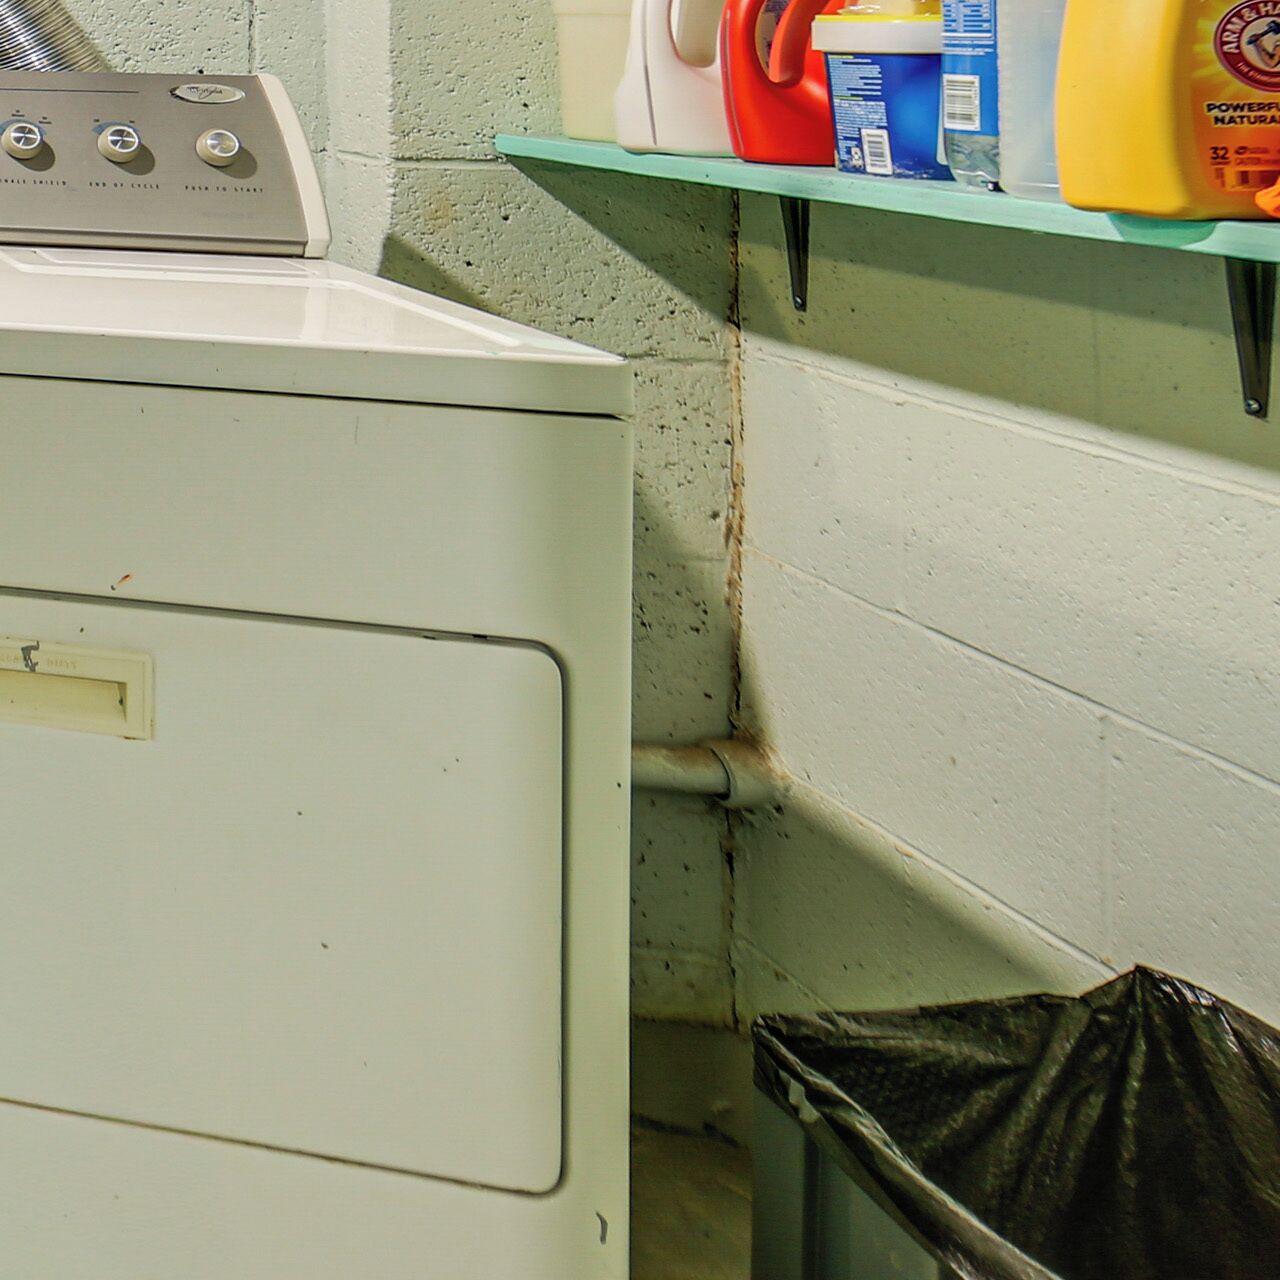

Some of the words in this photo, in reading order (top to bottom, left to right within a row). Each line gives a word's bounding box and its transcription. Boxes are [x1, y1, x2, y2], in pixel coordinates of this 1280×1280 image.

[1221, 16, 1247, 54] ARM
[1206, 102, 1280, 113] POWERF
[1214, 115, 1280, 125] NATURA
[1210, 146, 1230, 160] 32
